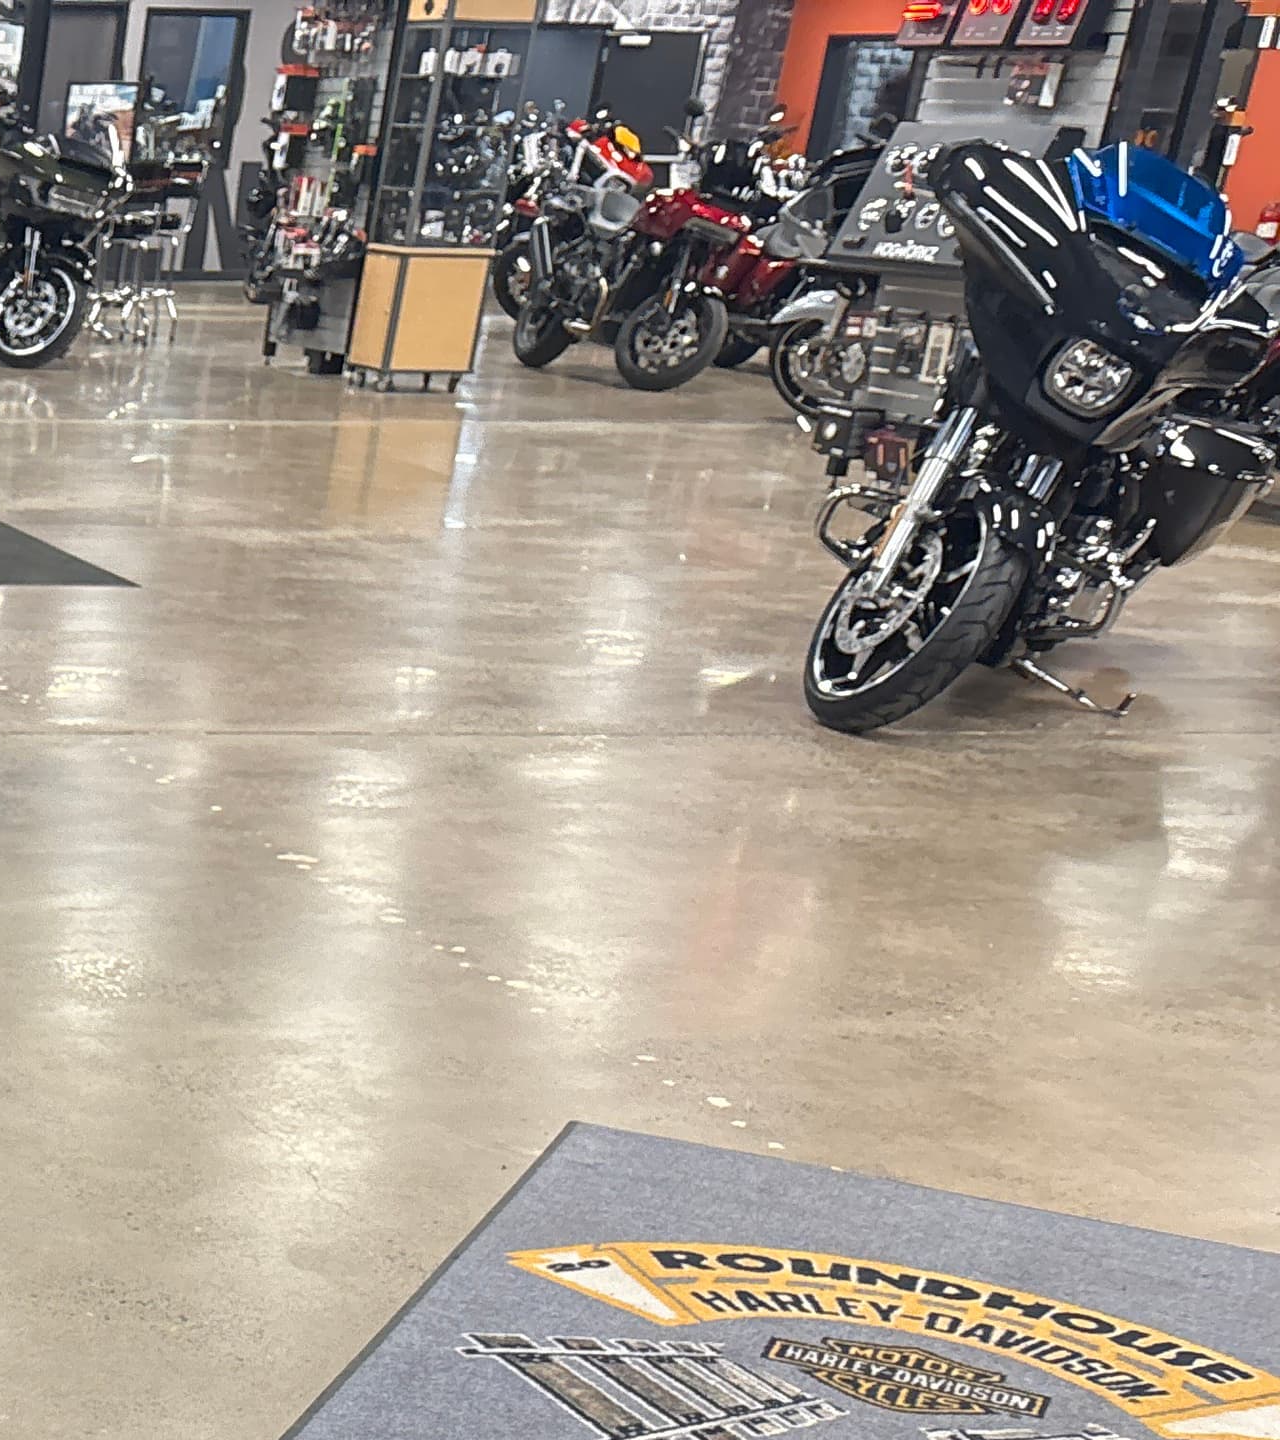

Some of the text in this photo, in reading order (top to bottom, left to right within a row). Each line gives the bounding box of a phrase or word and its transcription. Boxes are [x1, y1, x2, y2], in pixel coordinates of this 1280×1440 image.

[651, 1250, 1254, 1385] ROUNDHOUSE
[692, 1290, 1172, 1403] HARLEY-DAVIDSON
[785, 1343, 1031, 1410] HARLEY-DAVIDSON
[831, 1372, 962, 1410] CYCLES
